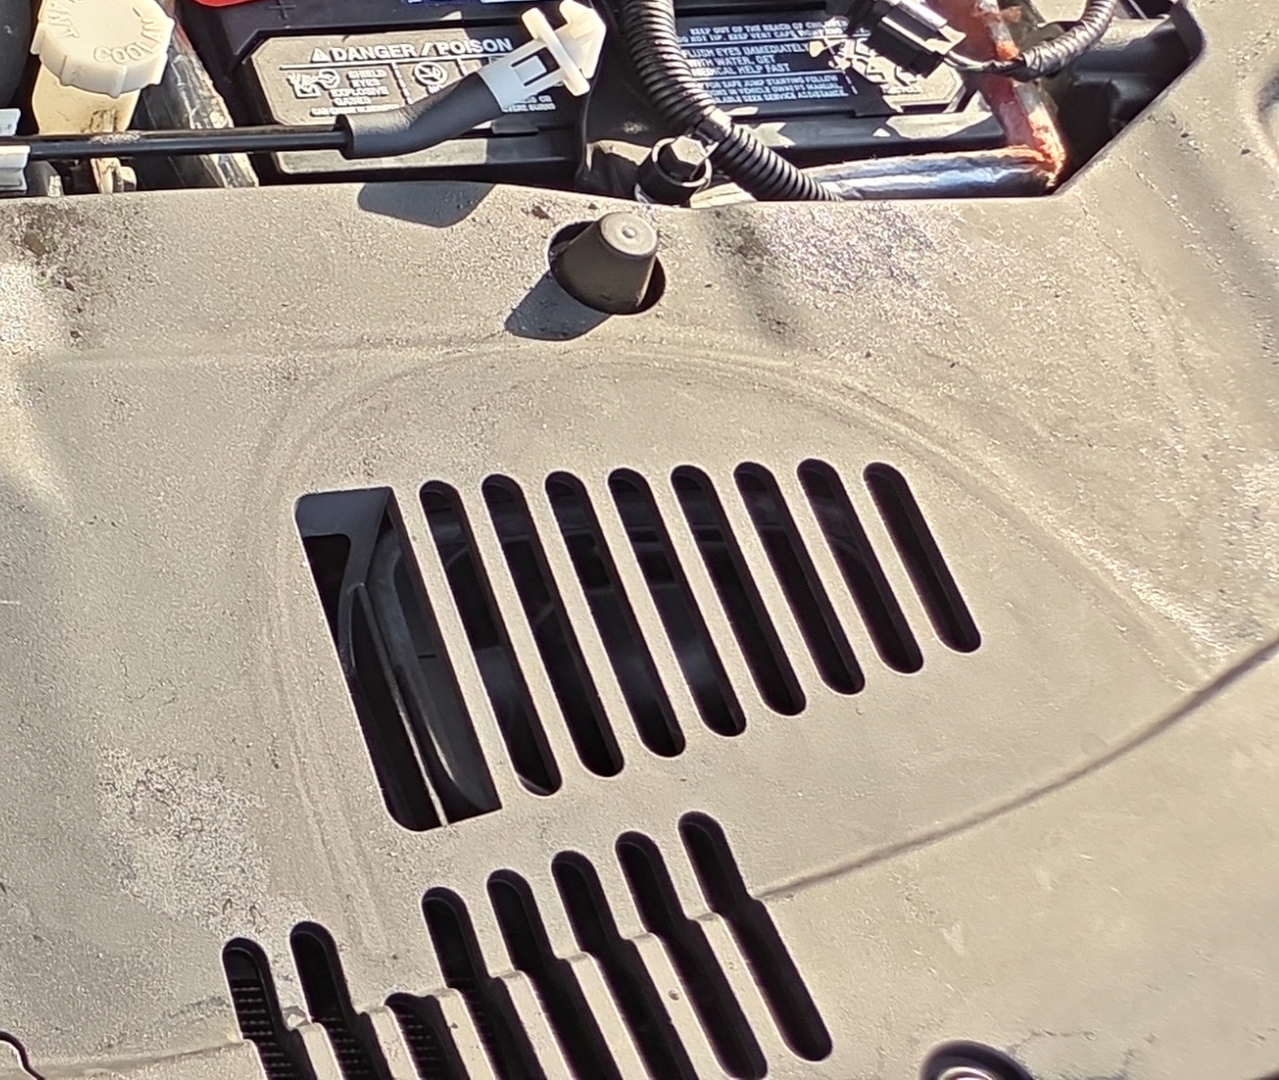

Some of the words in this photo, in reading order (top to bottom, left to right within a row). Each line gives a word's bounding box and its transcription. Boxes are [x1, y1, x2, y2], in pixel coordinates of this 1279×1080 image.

[330, 43, 418, 62] DANGER
[434, 38, 513, 56] POISON
[683, 49, 714, 59] FLUSH
[715, 47, 742, 57] EYES
[755, 54, 776, 64] GET
[692, 67, 737, 77] MEDICAL
[737, 65, 763, 75] HELP
[765, 62, 791, 73] FAST
[329, 86, 390, 98] EXPLOSIVE
